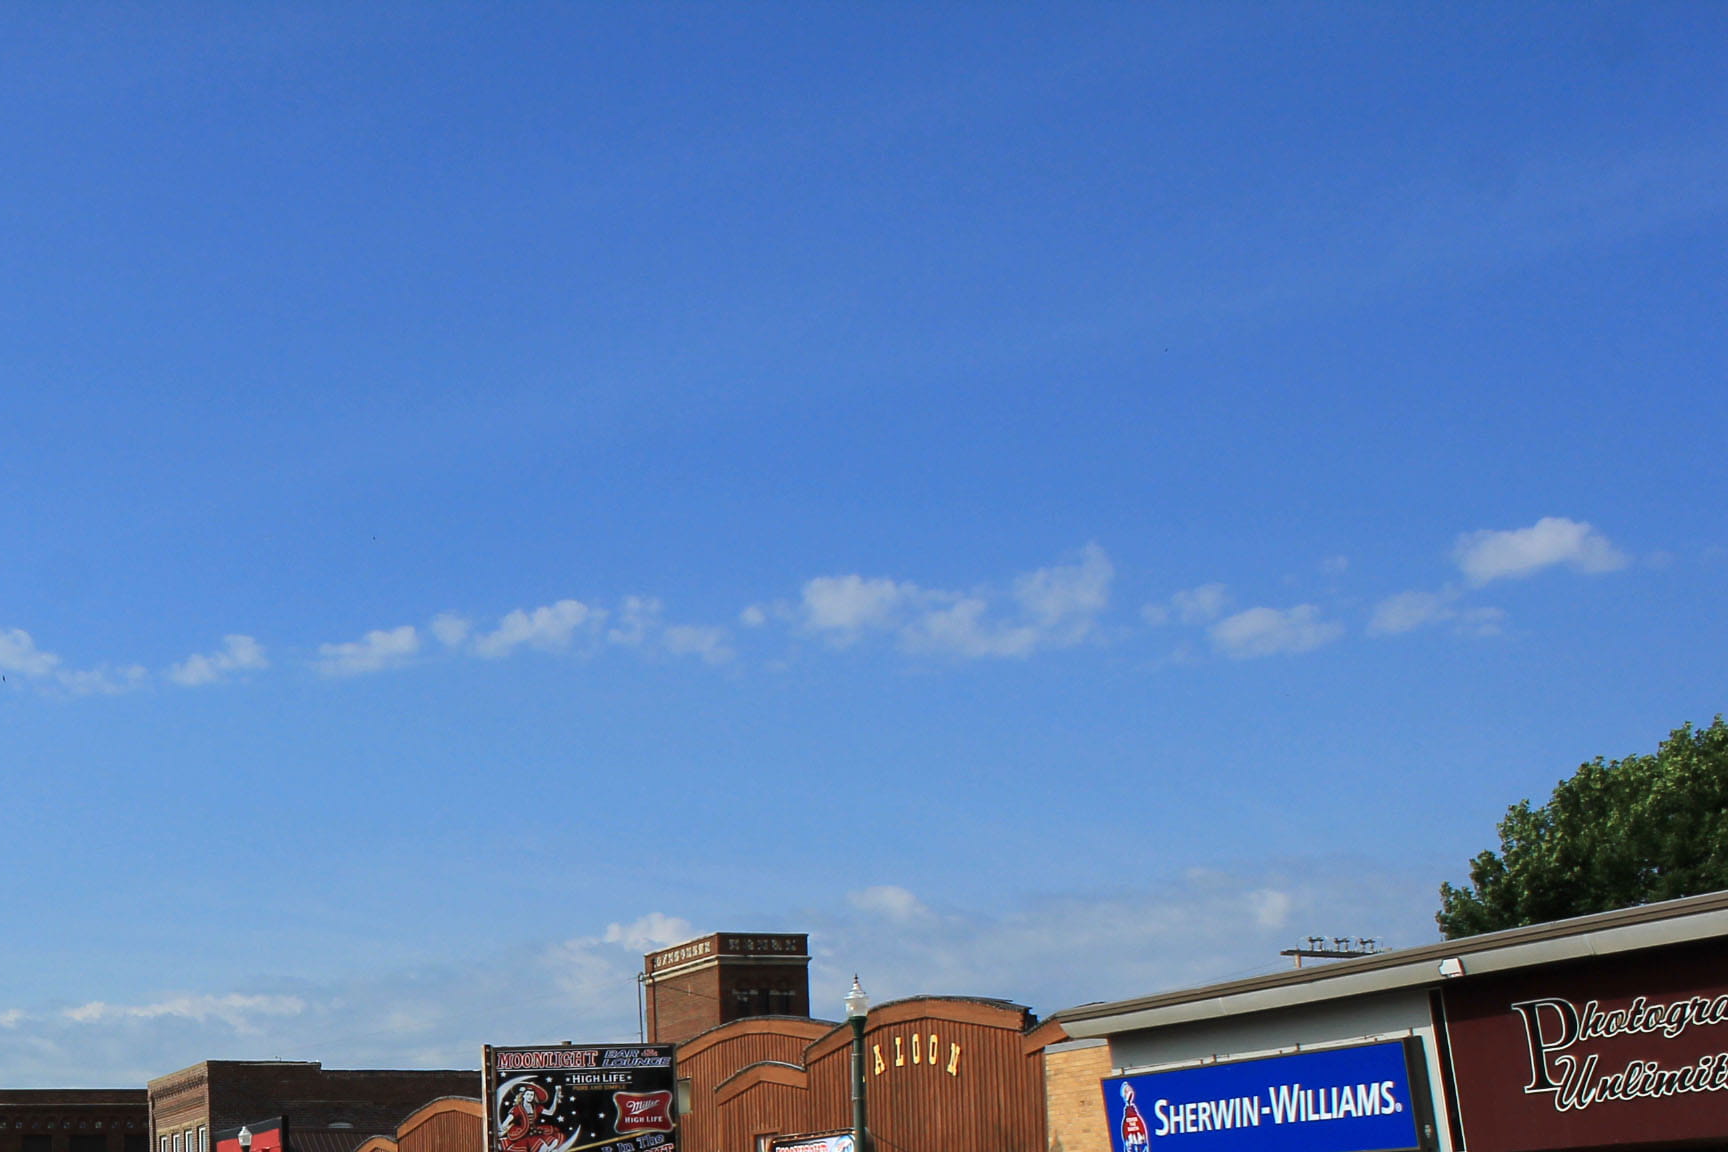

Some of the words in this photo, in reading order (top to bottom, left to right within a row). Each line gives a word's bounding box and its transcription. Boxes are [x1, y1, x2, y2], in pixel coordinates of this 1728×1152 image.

[497, 1051, 598, 1069] MOONLIGHT
[604, 1050, 640, 1059] BAR
[602, 1057, 671, 1068] LOUNGE
[863, 1033, 961, 1082] ALOON
[572, 1074, 601, 1084] HIGH
[602, 1074, 626, 1082] LIFE
[625, 1099, 660, 1115] Miller
[1154, 1080, 1396, 1136] SHERWIN-WILLIAMS
[636, 1134, 664, 1148] The
